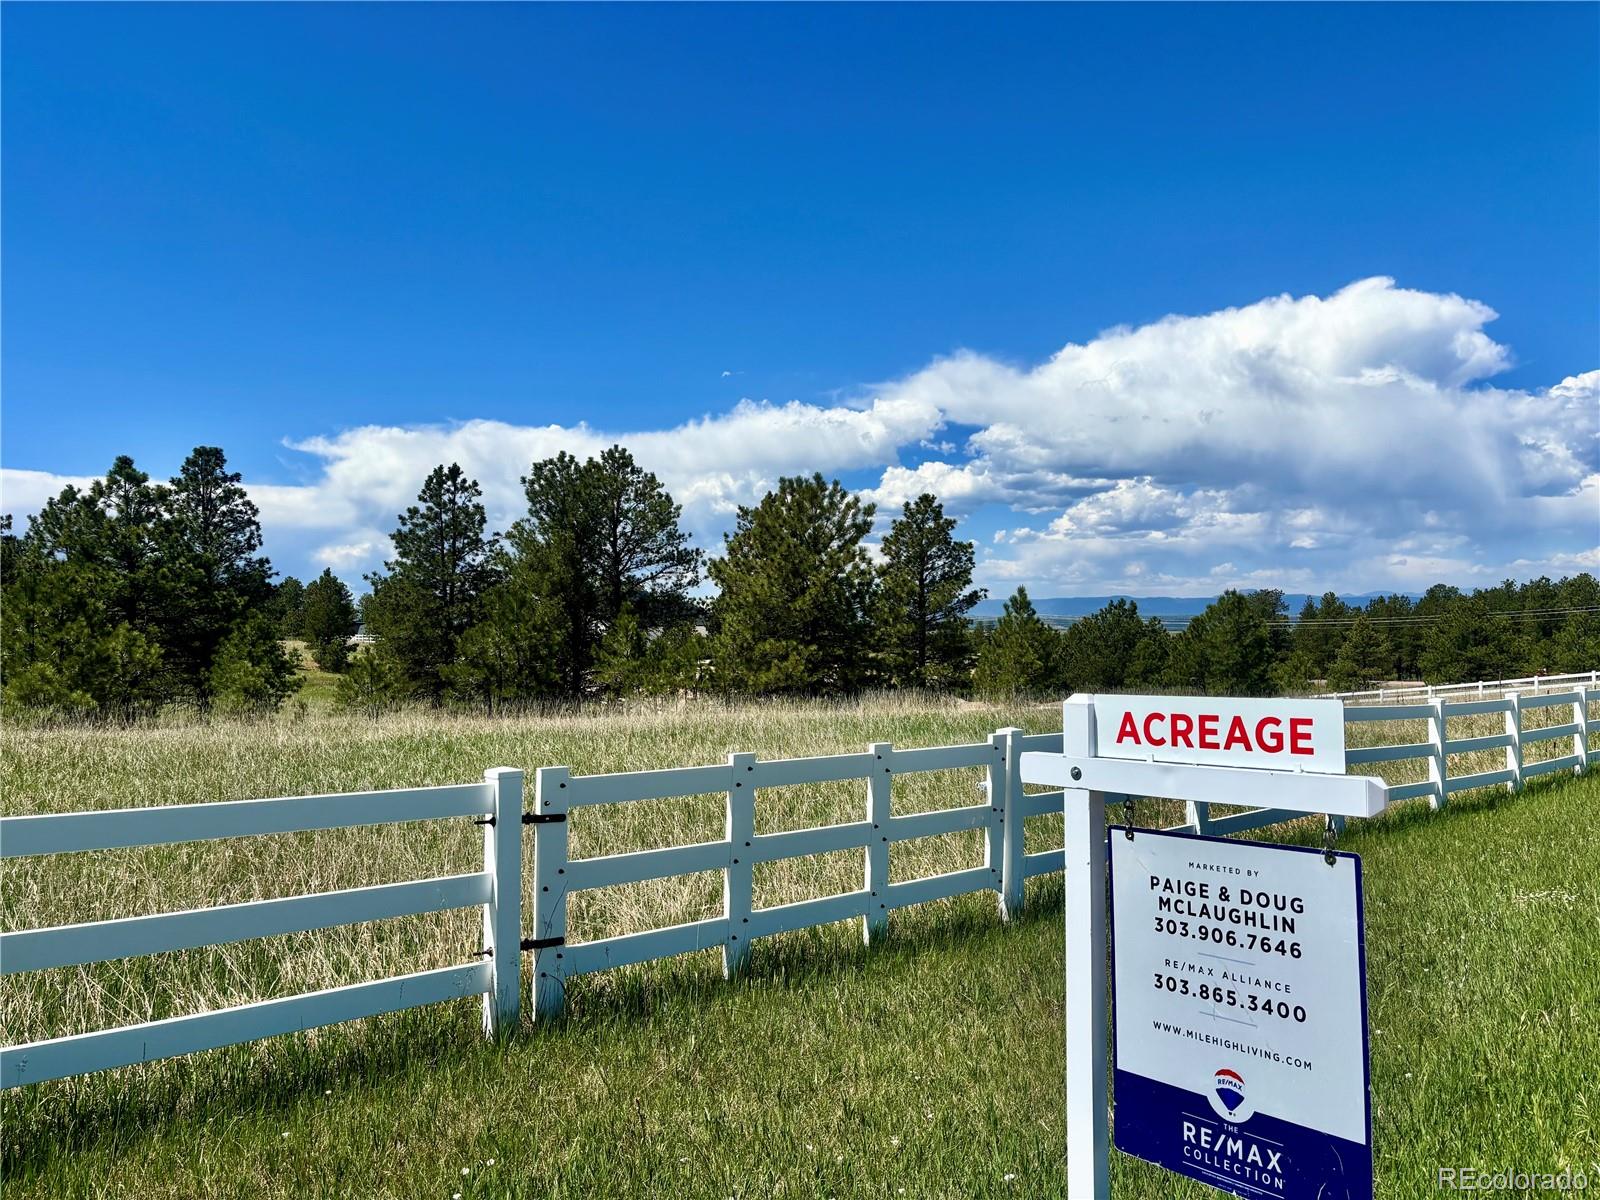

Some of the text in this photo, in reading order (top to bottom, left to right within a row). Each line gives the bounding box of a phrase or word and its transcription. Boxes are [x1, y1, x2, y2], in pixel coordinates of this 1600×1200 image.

[1116, 711, 1314, 755] ACREAGE
[1188, 862, 1259, 877] MARKETED BY
[1150, 875, 1304, 914] PAIGE & DOUG
[1158, 896, 1295, 934] MCLAUGHLIN
[1154, 917, 1302, 959] 303.906.7646
[1164, 958, 1291, 994] RE/MAX ALLIANCE
[1154, 973, 1307, 1023] 303.865.3400
[1153, 1020, 1312, 1071] WWW.MILEHIGHLIVING.COM
[1217, 1078, 1242, 1092] RE/MAX
[1183, 1121, 1282, 1174] RE/MAX
[1223, 1123, 1239, 1134] THE
[1183, 1145, 1283, 1190] COLLECTION
